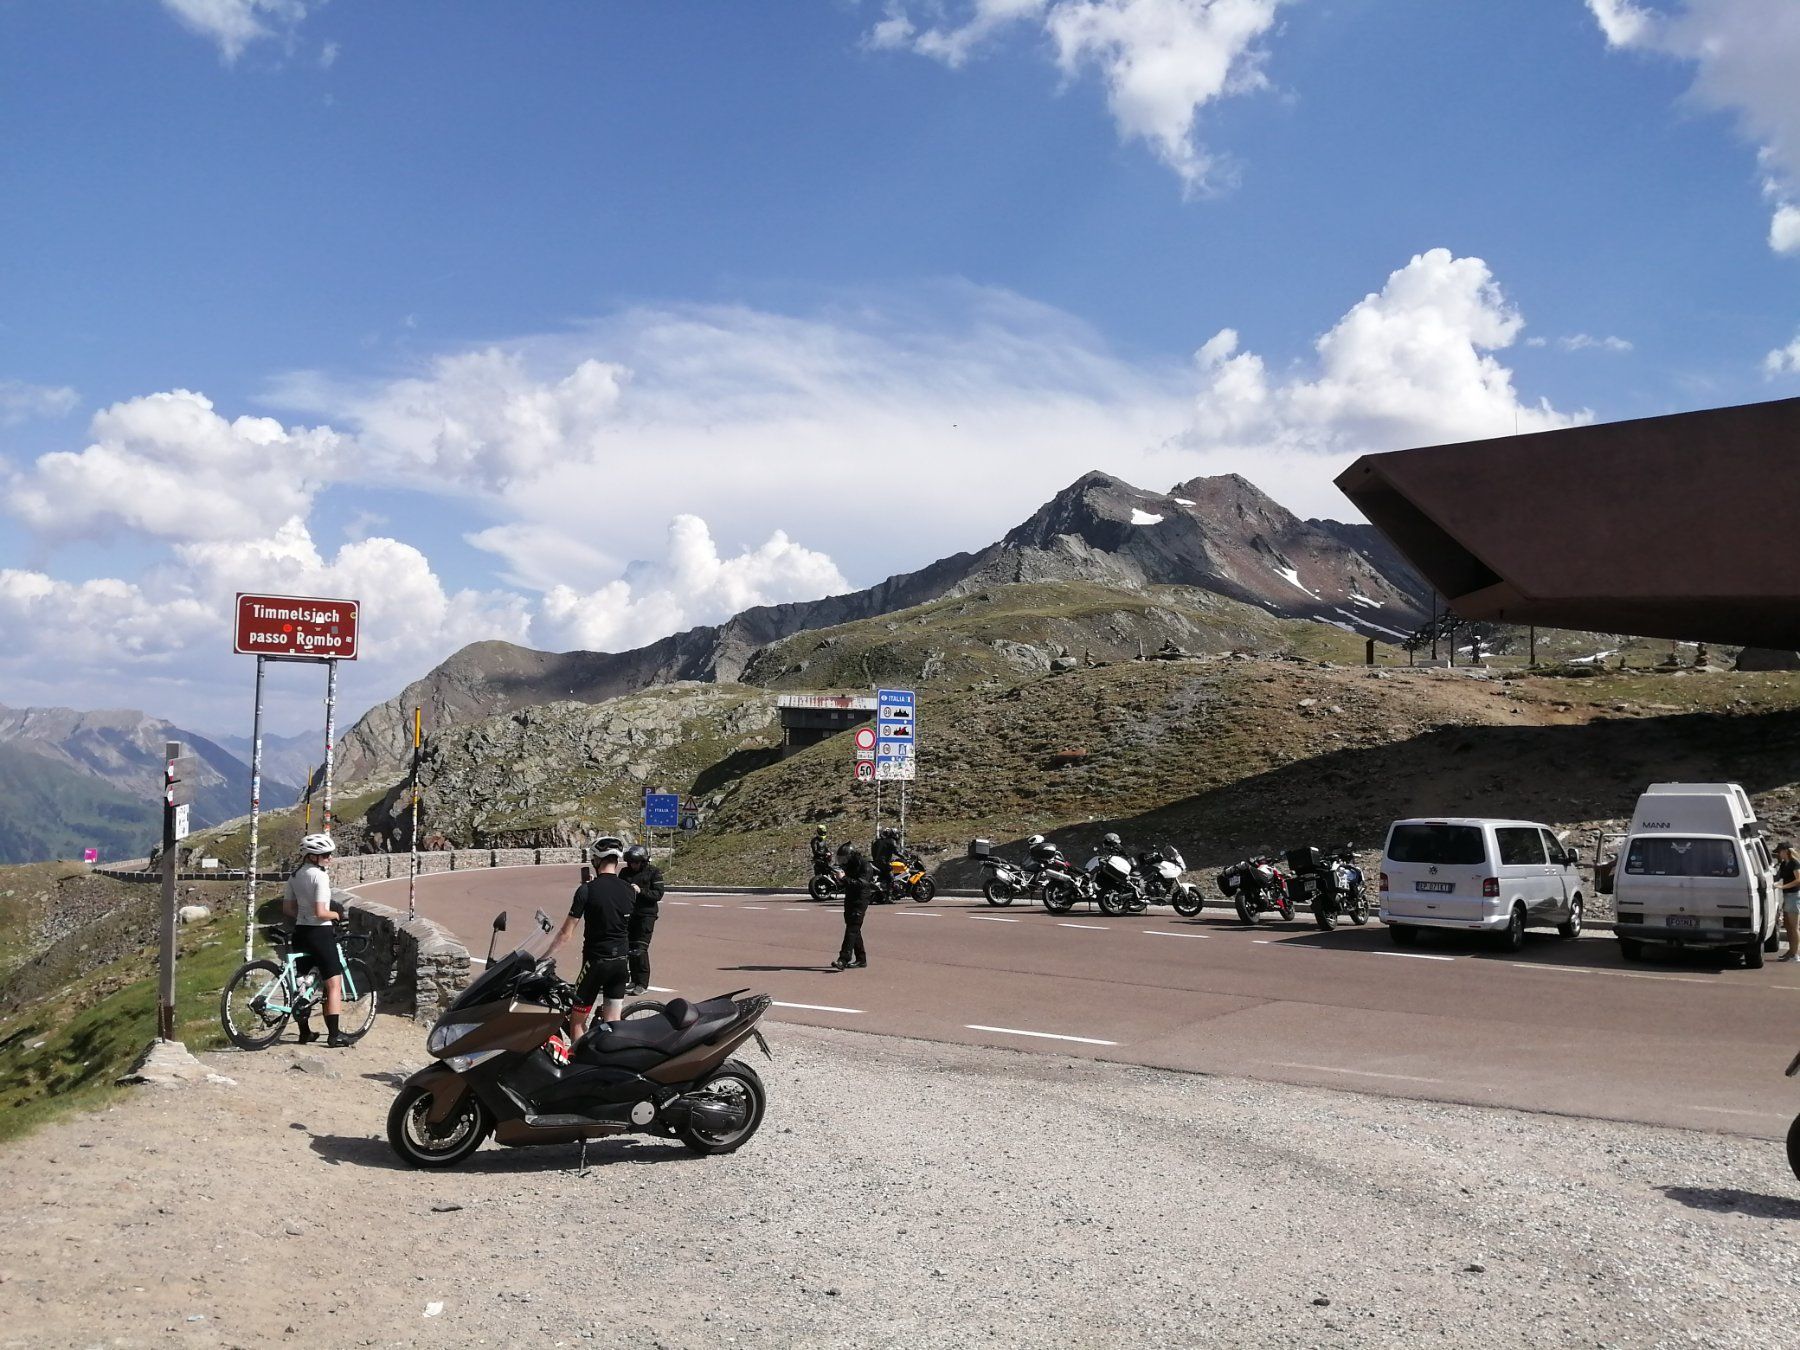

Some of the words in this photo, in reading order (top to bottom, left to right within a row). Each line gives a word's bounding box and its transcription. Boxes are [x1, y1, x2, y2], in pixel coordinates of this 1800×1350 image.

[253, 604, 340, 623] Timmelsjoch
[249, 631, 288, 644] passo
[296, 631, 342, 647] Rombo
[860, 765, 872, 776] 50
[1642, 821, 1671, 829] MANNI
